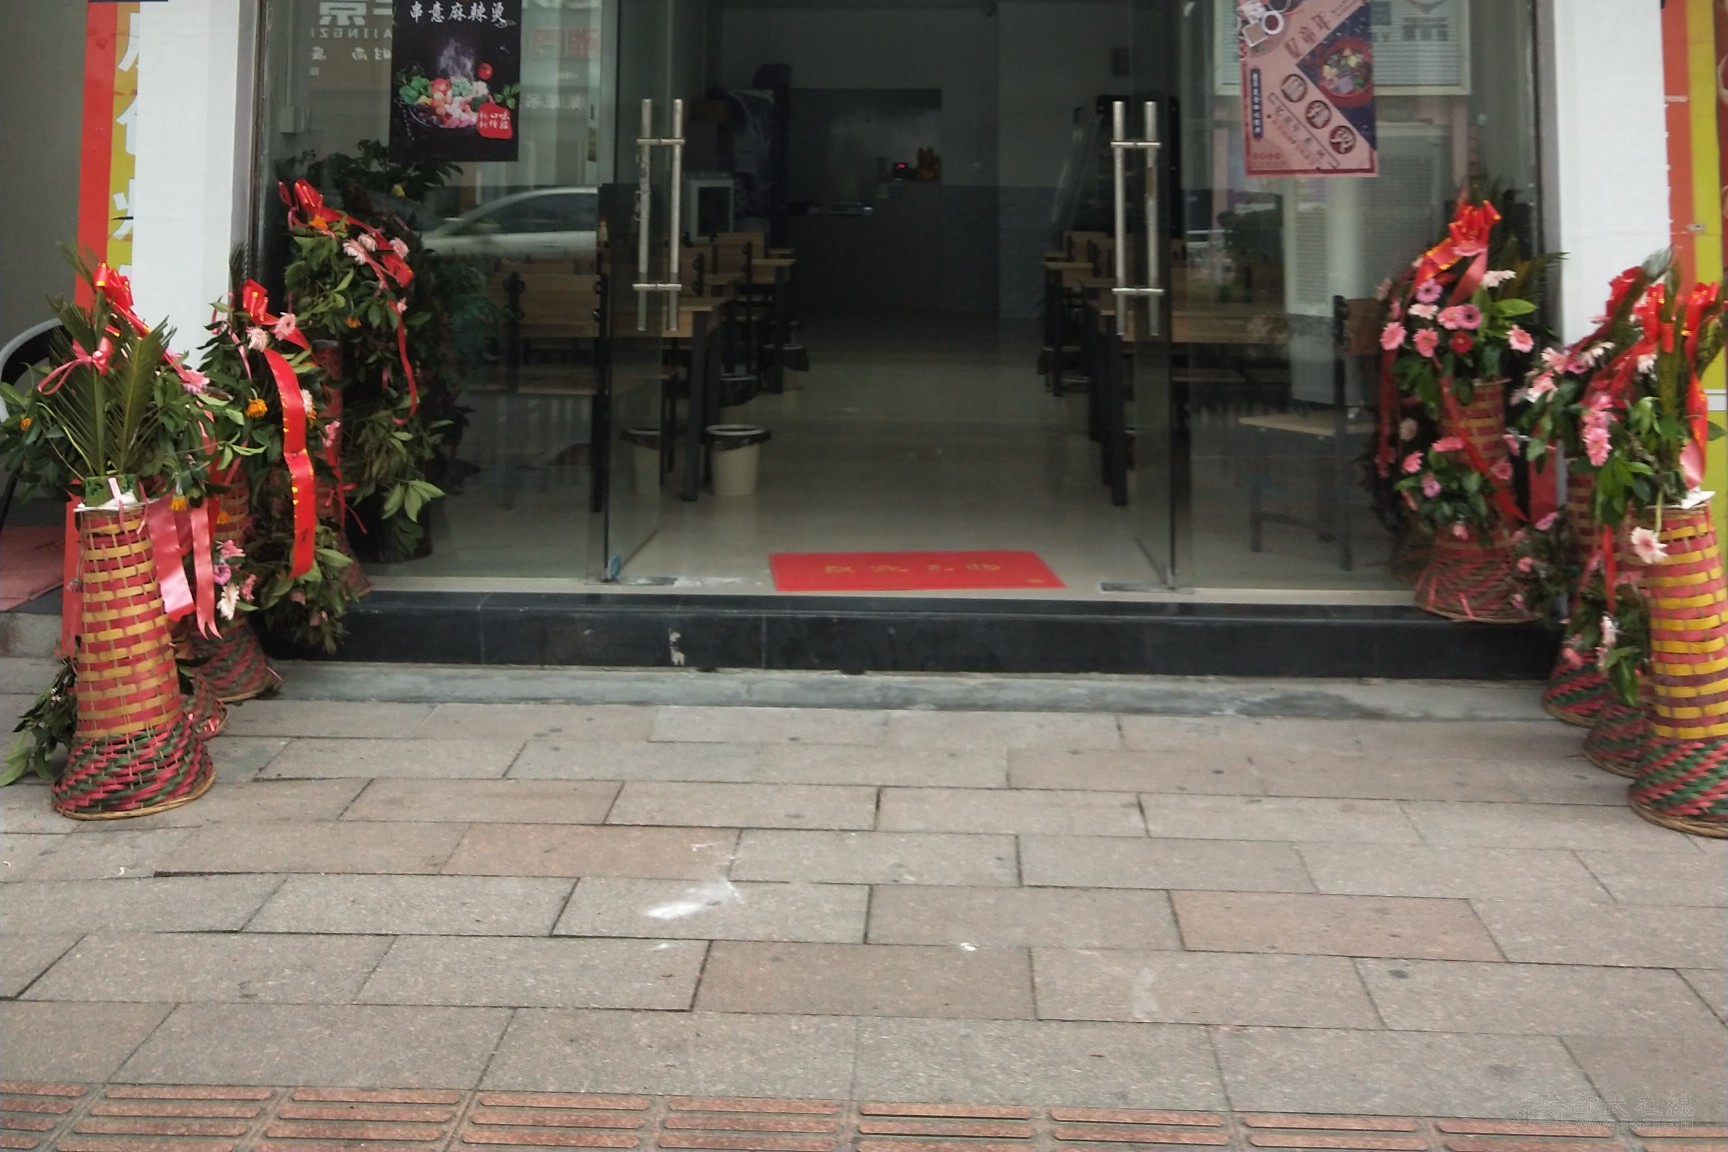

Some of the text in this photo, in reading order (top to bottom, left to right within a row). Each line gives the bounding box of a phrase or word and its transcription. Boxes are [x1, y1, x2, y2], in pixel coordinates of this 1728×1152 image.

[409, 0, 510, 27] 串意麻辣烫
